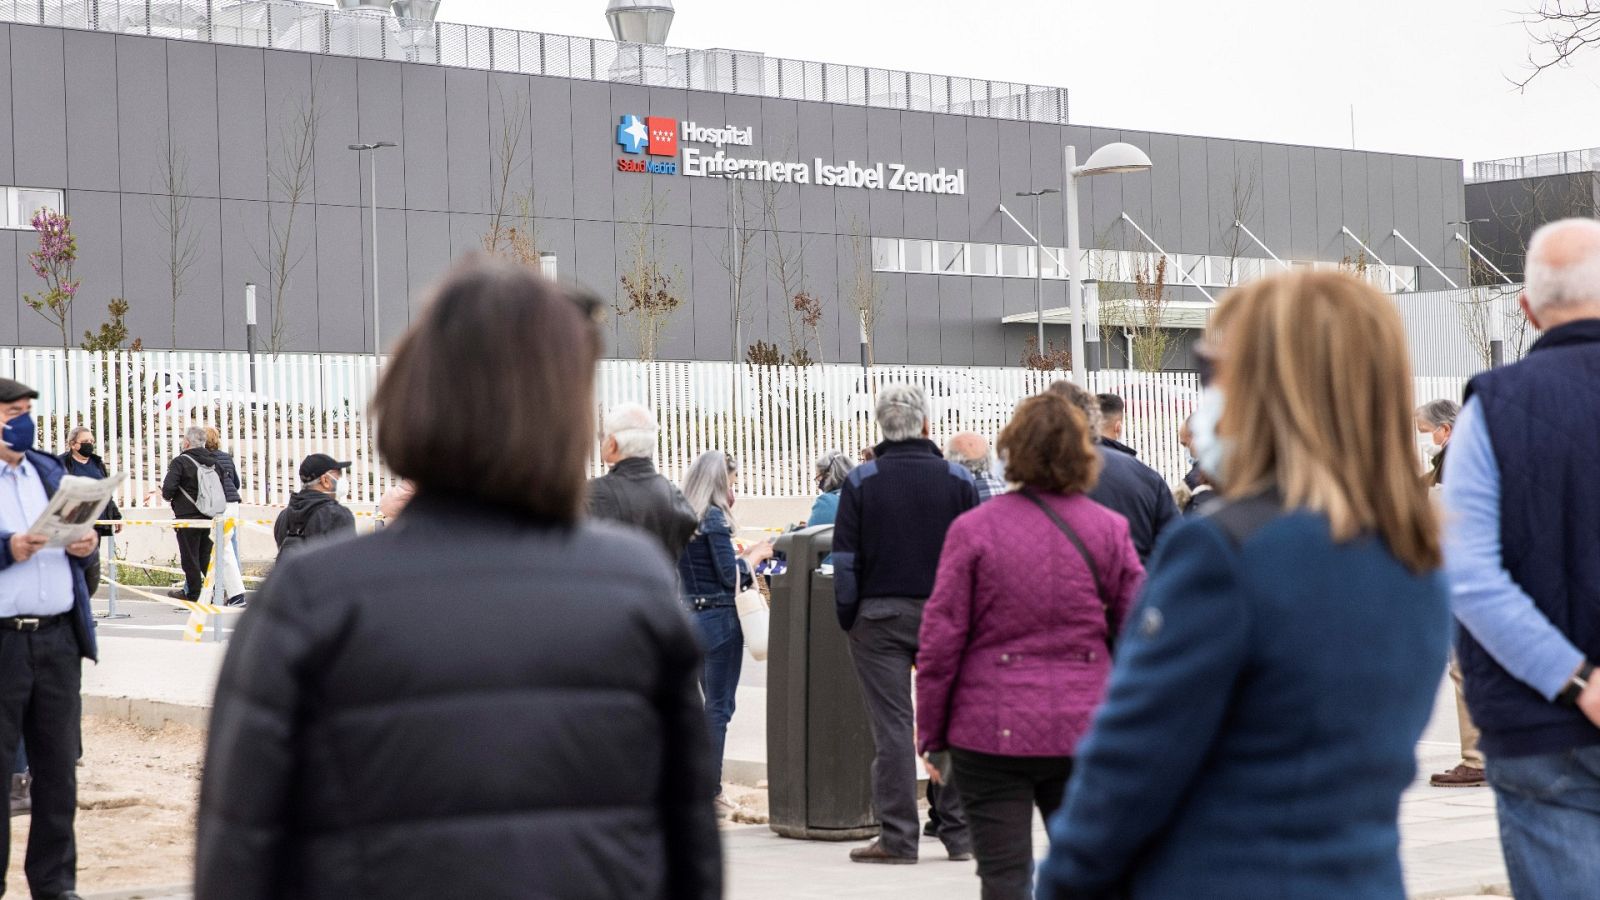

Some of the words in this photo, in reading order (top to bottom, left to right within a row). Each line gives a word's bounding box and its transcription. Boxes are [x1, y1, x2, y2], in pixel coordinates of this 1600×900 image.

[681, 121, 753, 147] Hospital
[682, 148, 809, 184] Enfermera
[815, 158, 883, 189] Isabel
[888, 164, 965, 195] Zendal
